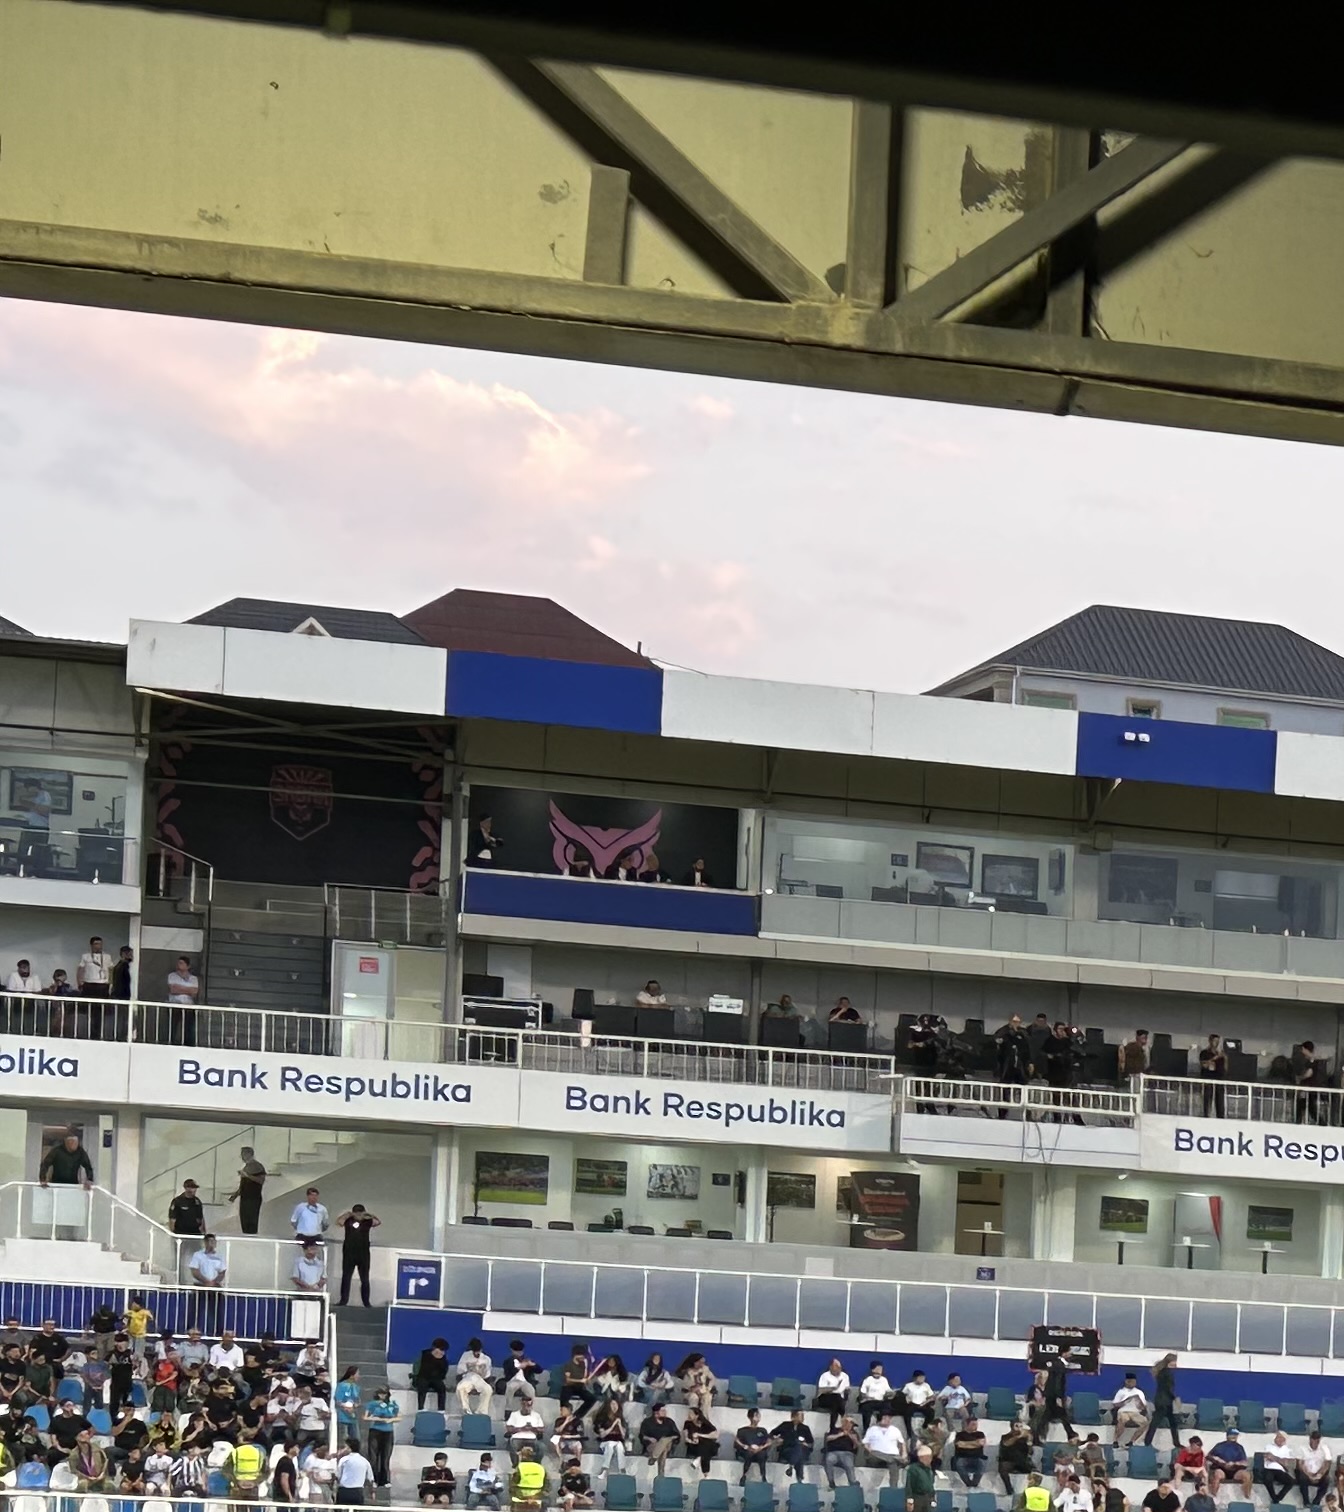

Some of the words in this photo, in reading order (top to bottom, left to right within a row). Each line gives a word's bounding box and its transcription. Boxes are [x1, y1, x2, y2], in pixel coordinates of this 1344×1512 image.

[178, 1059, 269, 1090] Bank
[280, 1066, 472, 1103] Respublika
[565, 1085, 652, 1116] Bank
[662, 1092, 846, 1129] Respublika
[1174, 1127, 1254, 1157] Bank
